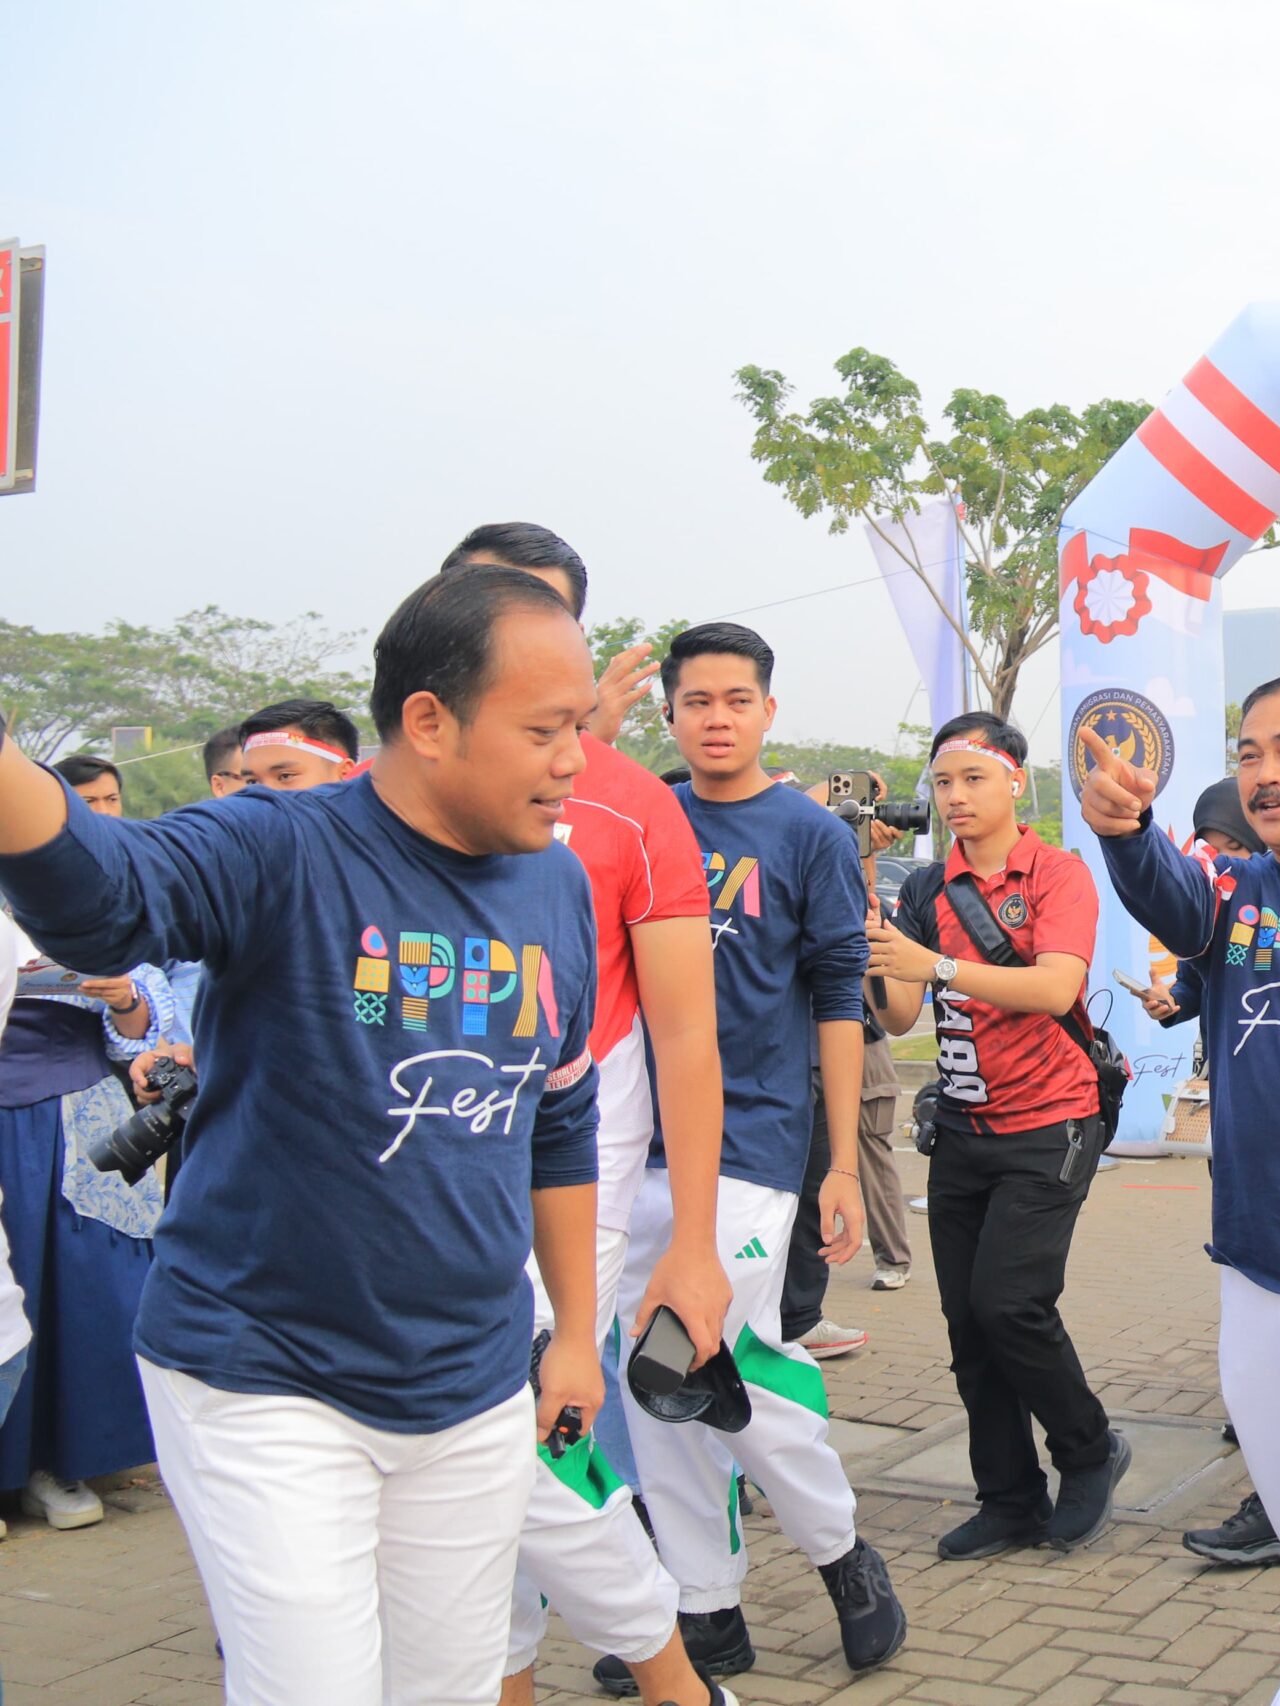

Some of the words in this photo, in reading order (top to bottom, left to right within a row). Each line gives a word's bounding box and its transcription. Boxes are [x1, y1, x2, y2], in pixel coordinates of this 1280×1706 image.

[1080, 692, 1111, 715] IMIGRASI
[1113, 691, 1133, 701] DAN
[1135, 698, 1172, 775] PEMASYARAKATAN
[379, 1046, 546, 1163] Fest
[1133, 1052, 1187, 1088] Fest
